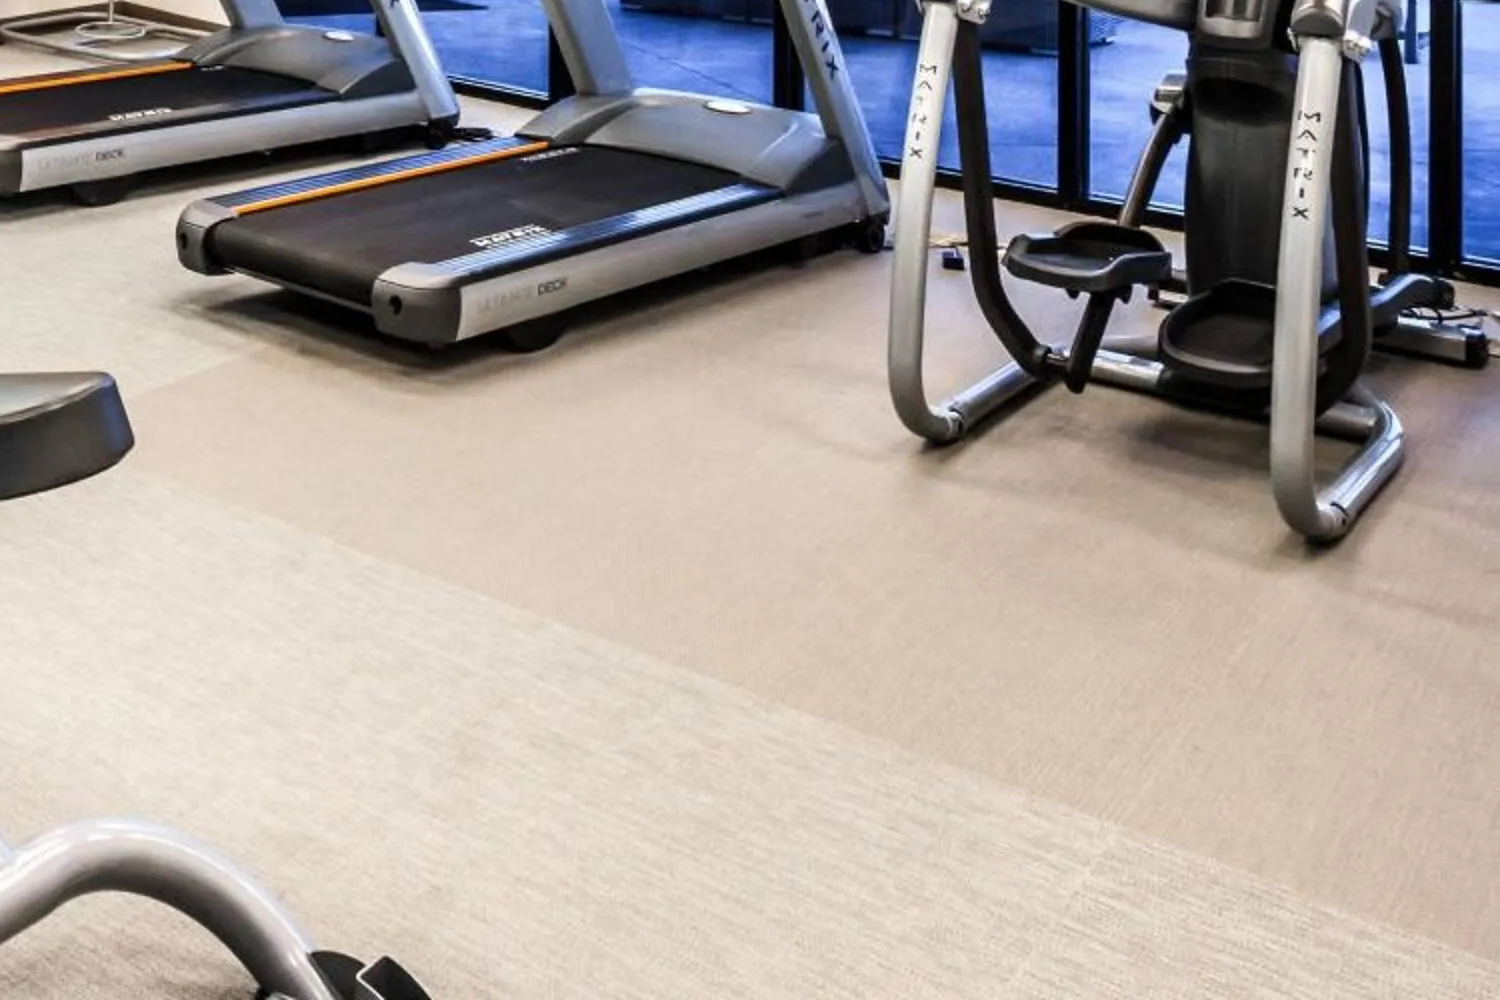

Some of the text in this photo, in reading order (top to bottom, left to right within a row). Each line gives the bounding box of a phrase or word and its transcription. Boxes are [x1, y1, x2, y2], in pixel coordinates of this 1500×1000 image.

[909, 64, 937, 159] MATRIX
[1292, 111, 1321, 219] MATRIX
[538, 277, 568, 296] DECK
